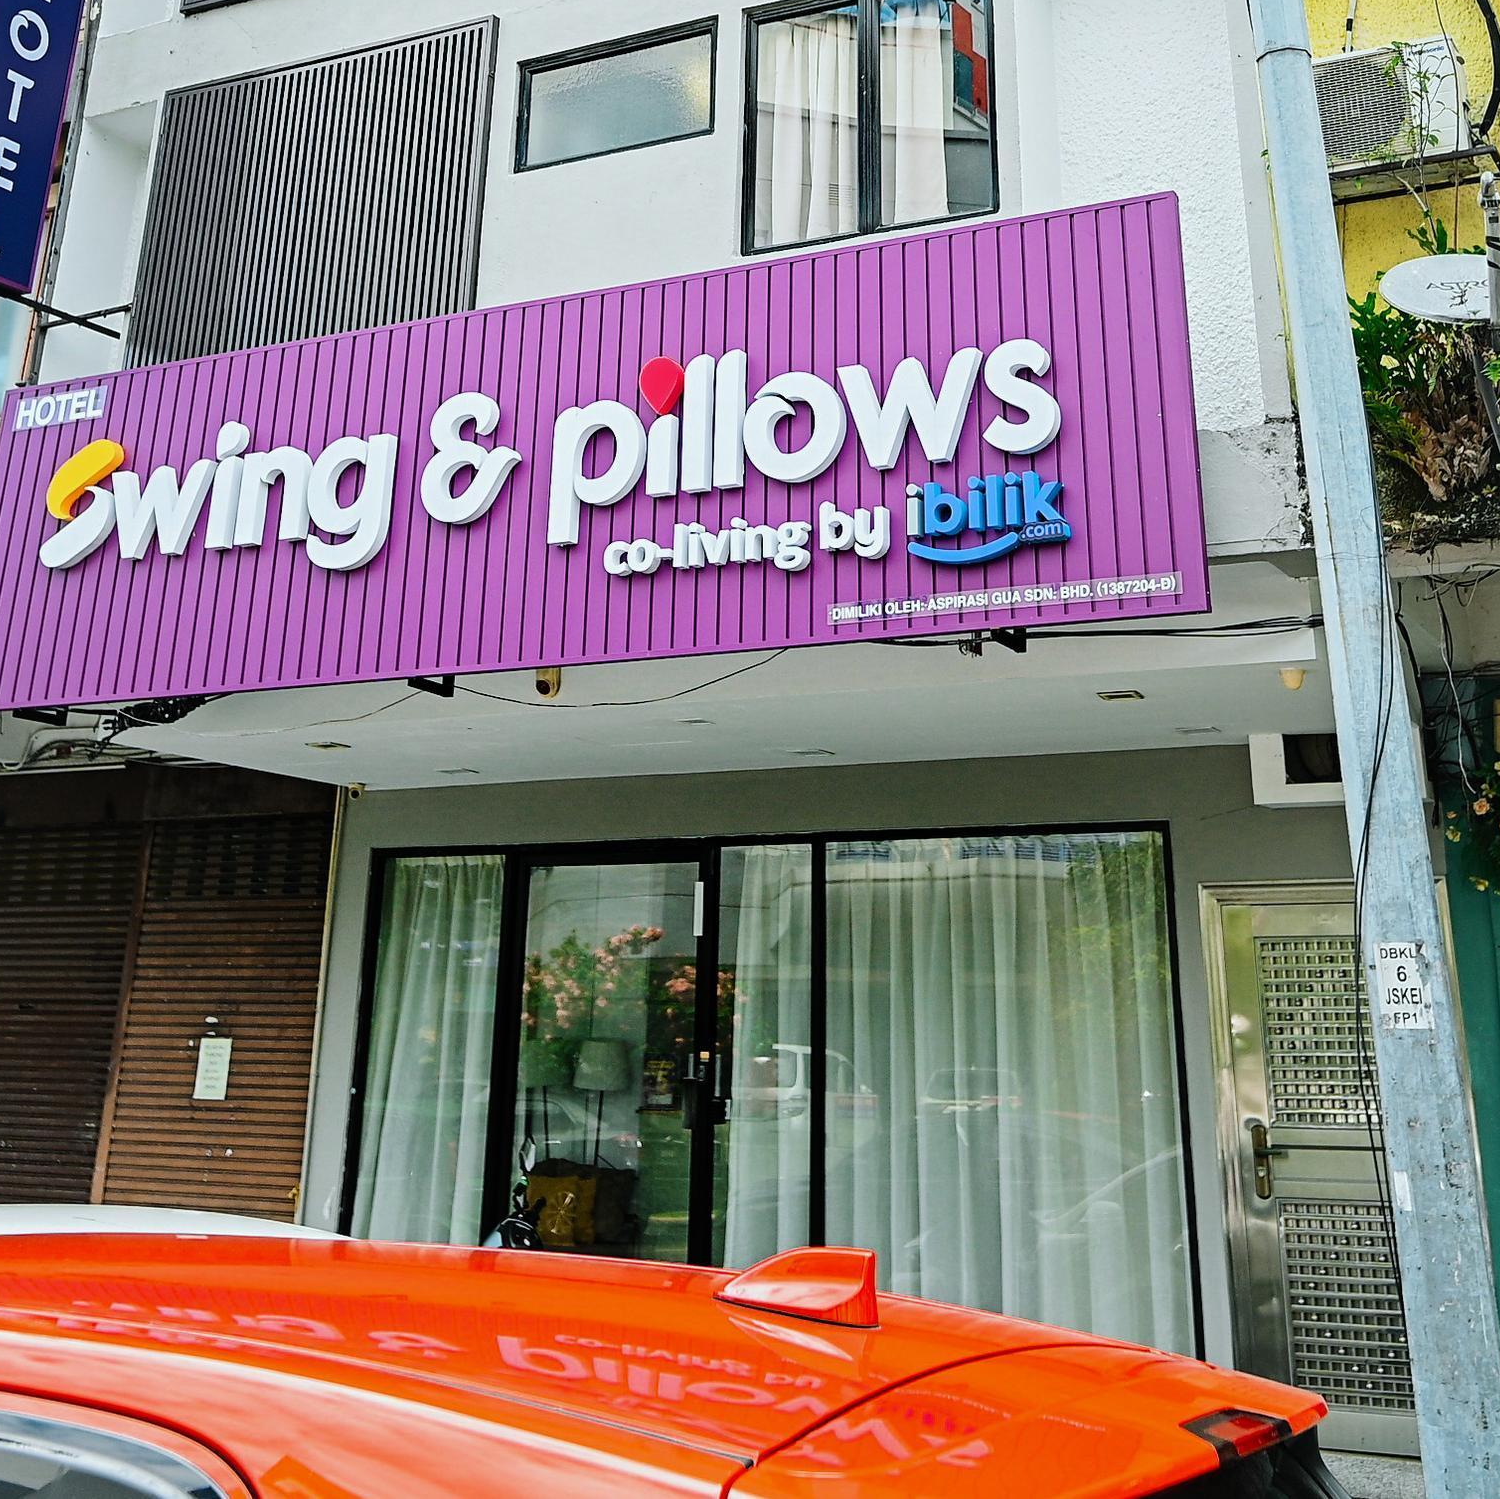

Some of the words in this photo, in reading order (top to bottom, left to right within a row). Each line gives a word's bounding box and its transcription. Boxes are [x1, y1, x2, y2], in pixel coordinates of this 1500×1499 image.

[16, 388, 103, 429] HOTEL
[419, 390, 522, 526] &
[547, 338, 1062, 547] pillows
[603, 516, 812, 577] co-living
[818, 500, 891, 560] by
[831, 603, 883, 622] DIMILIKI
[927, 592, 989, 612] ASPIRASI
[990, 589, 1022, 606] GUA
[1380, 947, 1418, 959] DBKL
[1396, 965, 1408, 983] 6
